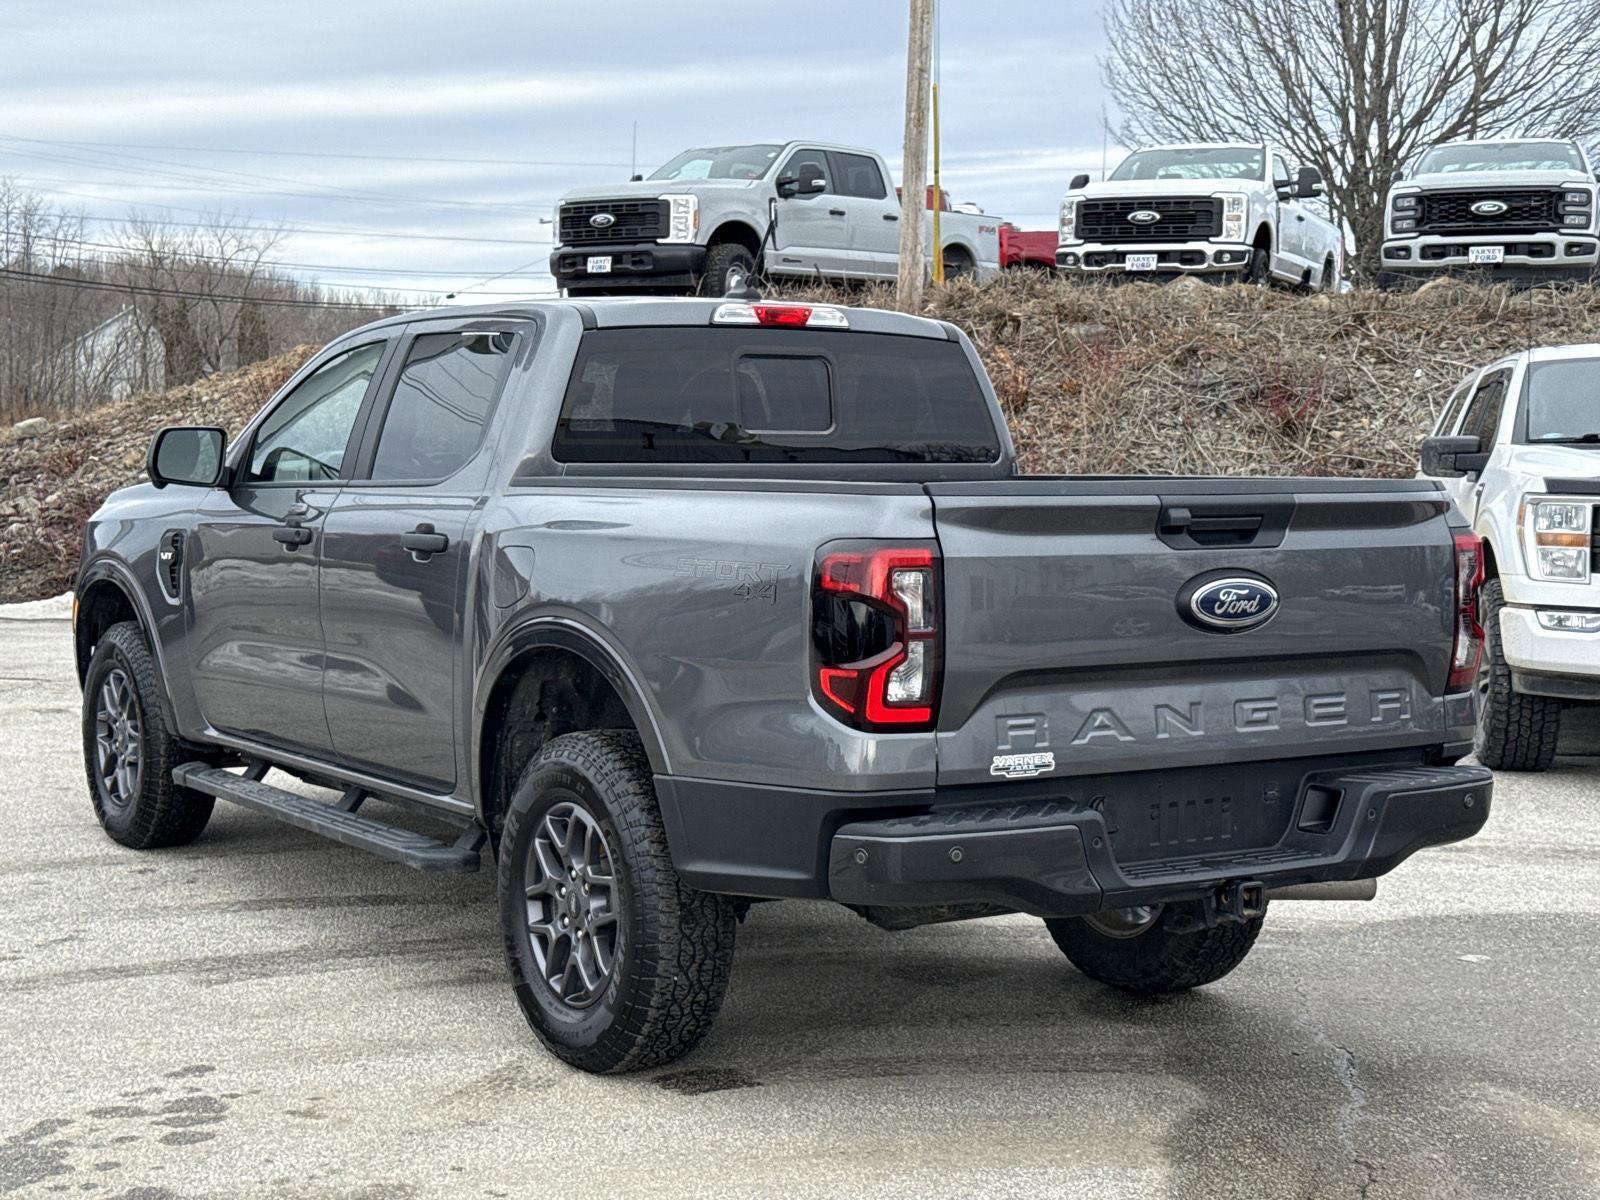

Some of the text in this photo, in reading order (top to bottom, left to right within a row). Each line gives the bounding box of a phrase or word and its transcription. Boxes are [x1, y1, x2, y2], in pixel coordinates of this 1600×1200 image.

[673, 558, 792, 583] SPORT
[1214, 588, 1261, 615] Ford
[994, 687, 1412, 751] RANGER
[994, 753, 1053, 768] VARNEY
